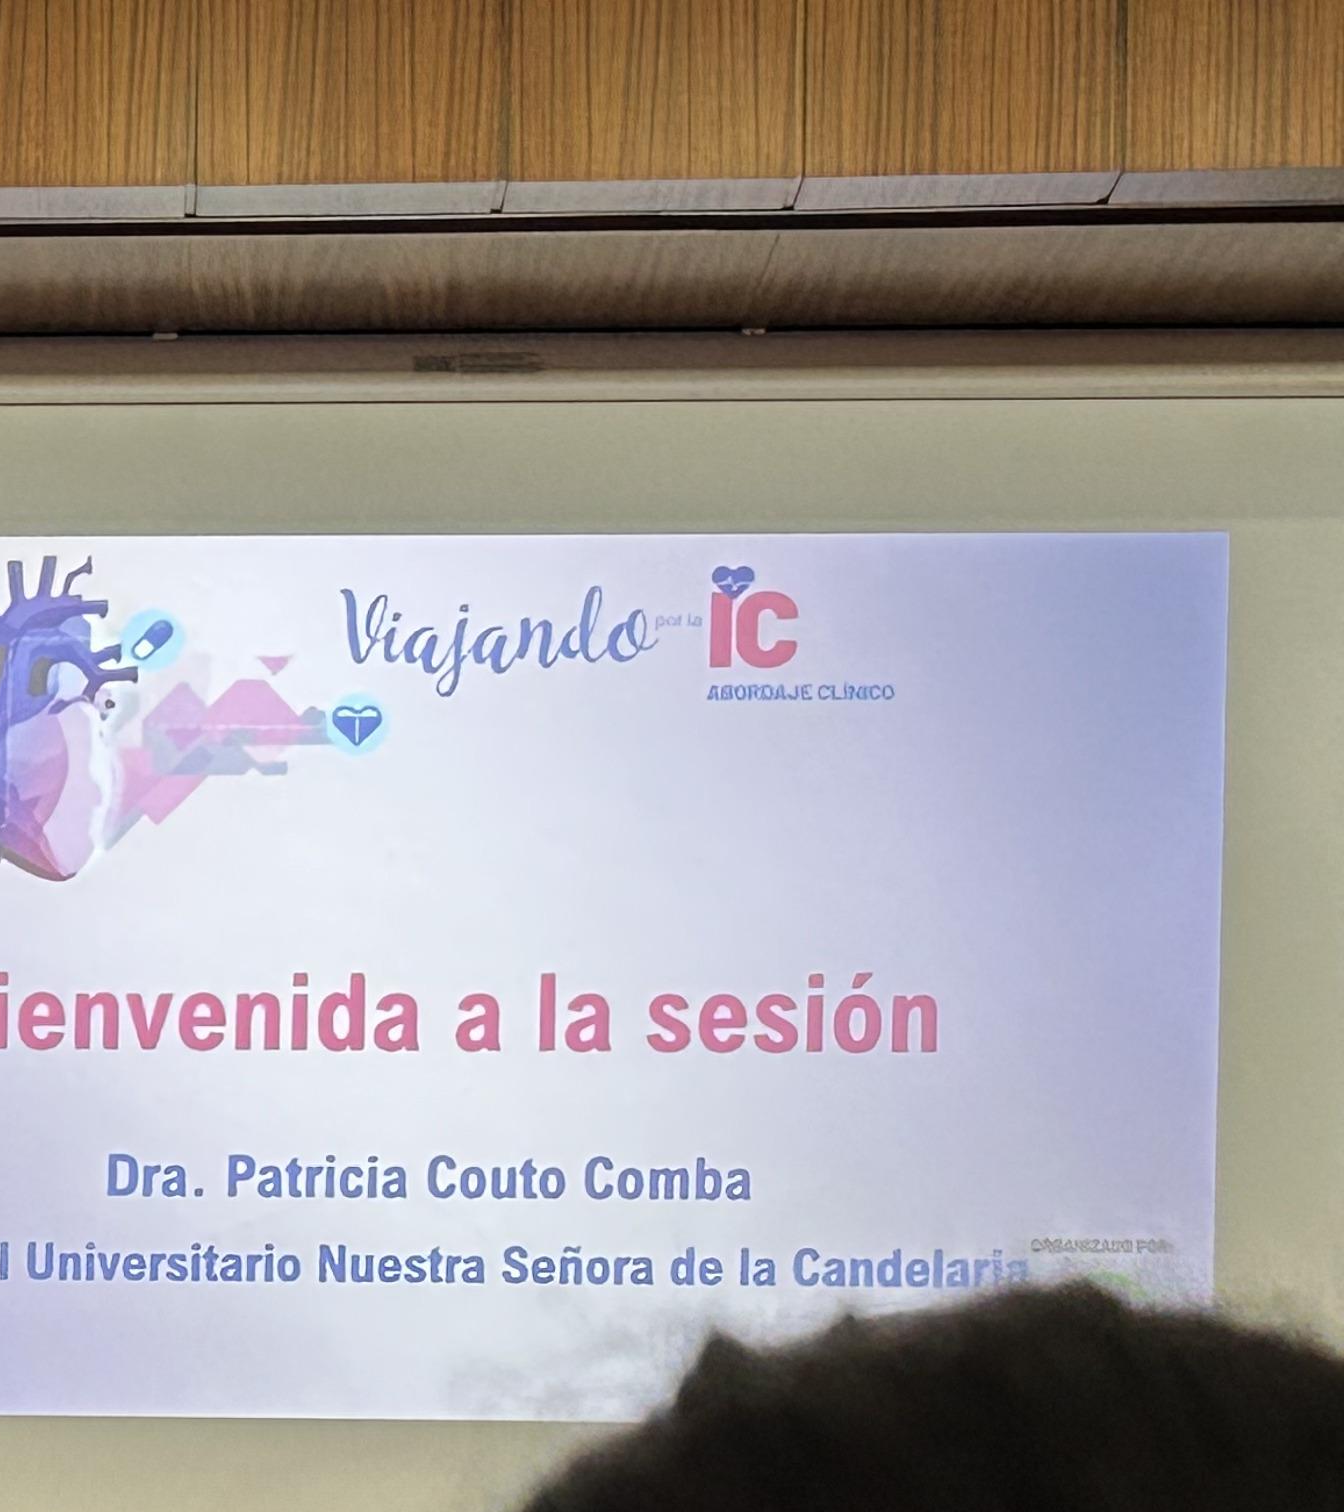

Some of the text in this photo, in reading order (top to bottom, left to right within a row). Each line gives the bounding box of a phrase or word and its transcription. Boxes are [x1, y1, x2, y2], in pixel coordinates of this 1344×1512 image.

[340, 586, 658, 697] Viajando
[707, 684, 812, 701] ABORDAJE
[455, 993, 502, 1053] a
[539, 973, 611, 1053] la
[647, 972, 938, 1054] sesión
[107, 1153, 751, 1200] Dra. Patricia Couto Comba
[26, 1241, 302, 1283] Universitario
[318, 1244, 486, 1285] Nuestra
[501, 1245, 655, 1287] Señora
[670, 1247, 724, 1287] de
[739, 1248, 777, 1287] la
[792, 1248, 1028, 1287] Candelaria
